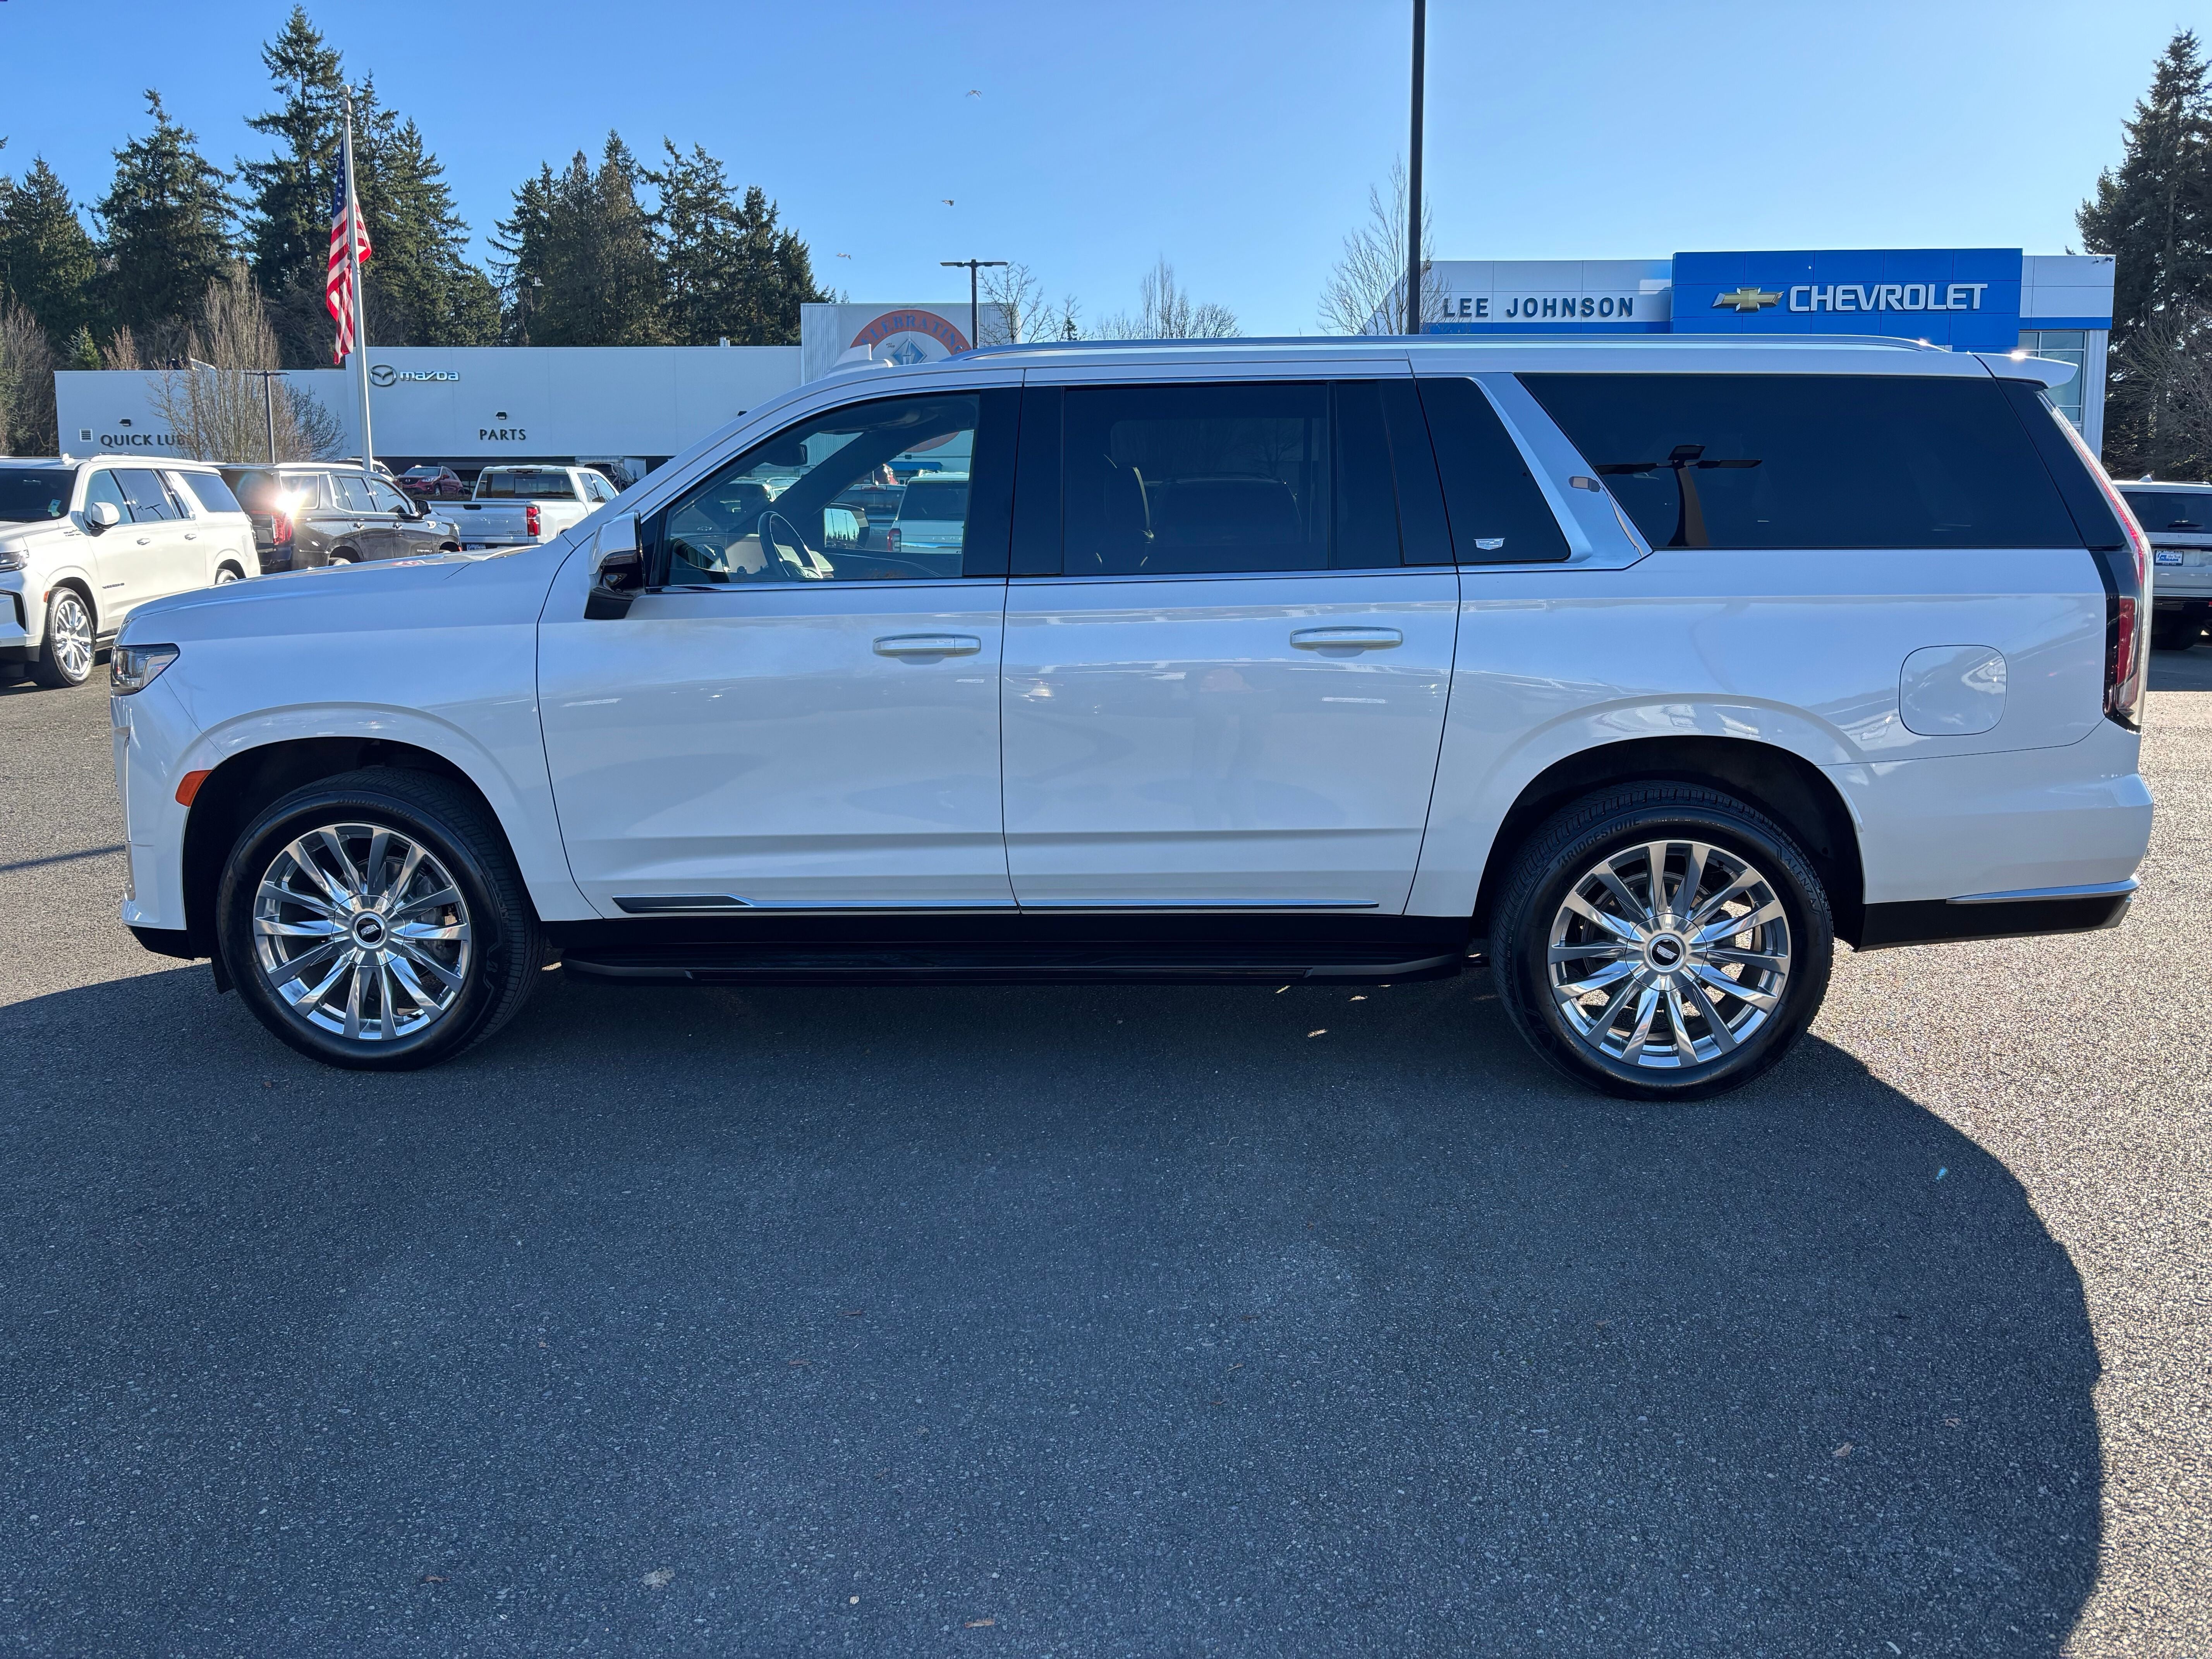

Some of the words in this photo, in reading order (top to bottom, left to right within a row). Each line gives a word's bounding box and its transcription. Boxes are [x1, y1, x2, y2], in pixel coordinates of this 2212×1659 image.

[1443, 298, 1488, 317] LEE
[1507, 297, 1633, 317] JOHNSON
[1790, 283, 1988, 311] CHEVROLET
[100, 434, 153, 448] QUICK
[157, 434, 193, 446] LUB
[480, 429, 526, 440] PARTS
[1785, 858, 1817, 905] ALENZA
